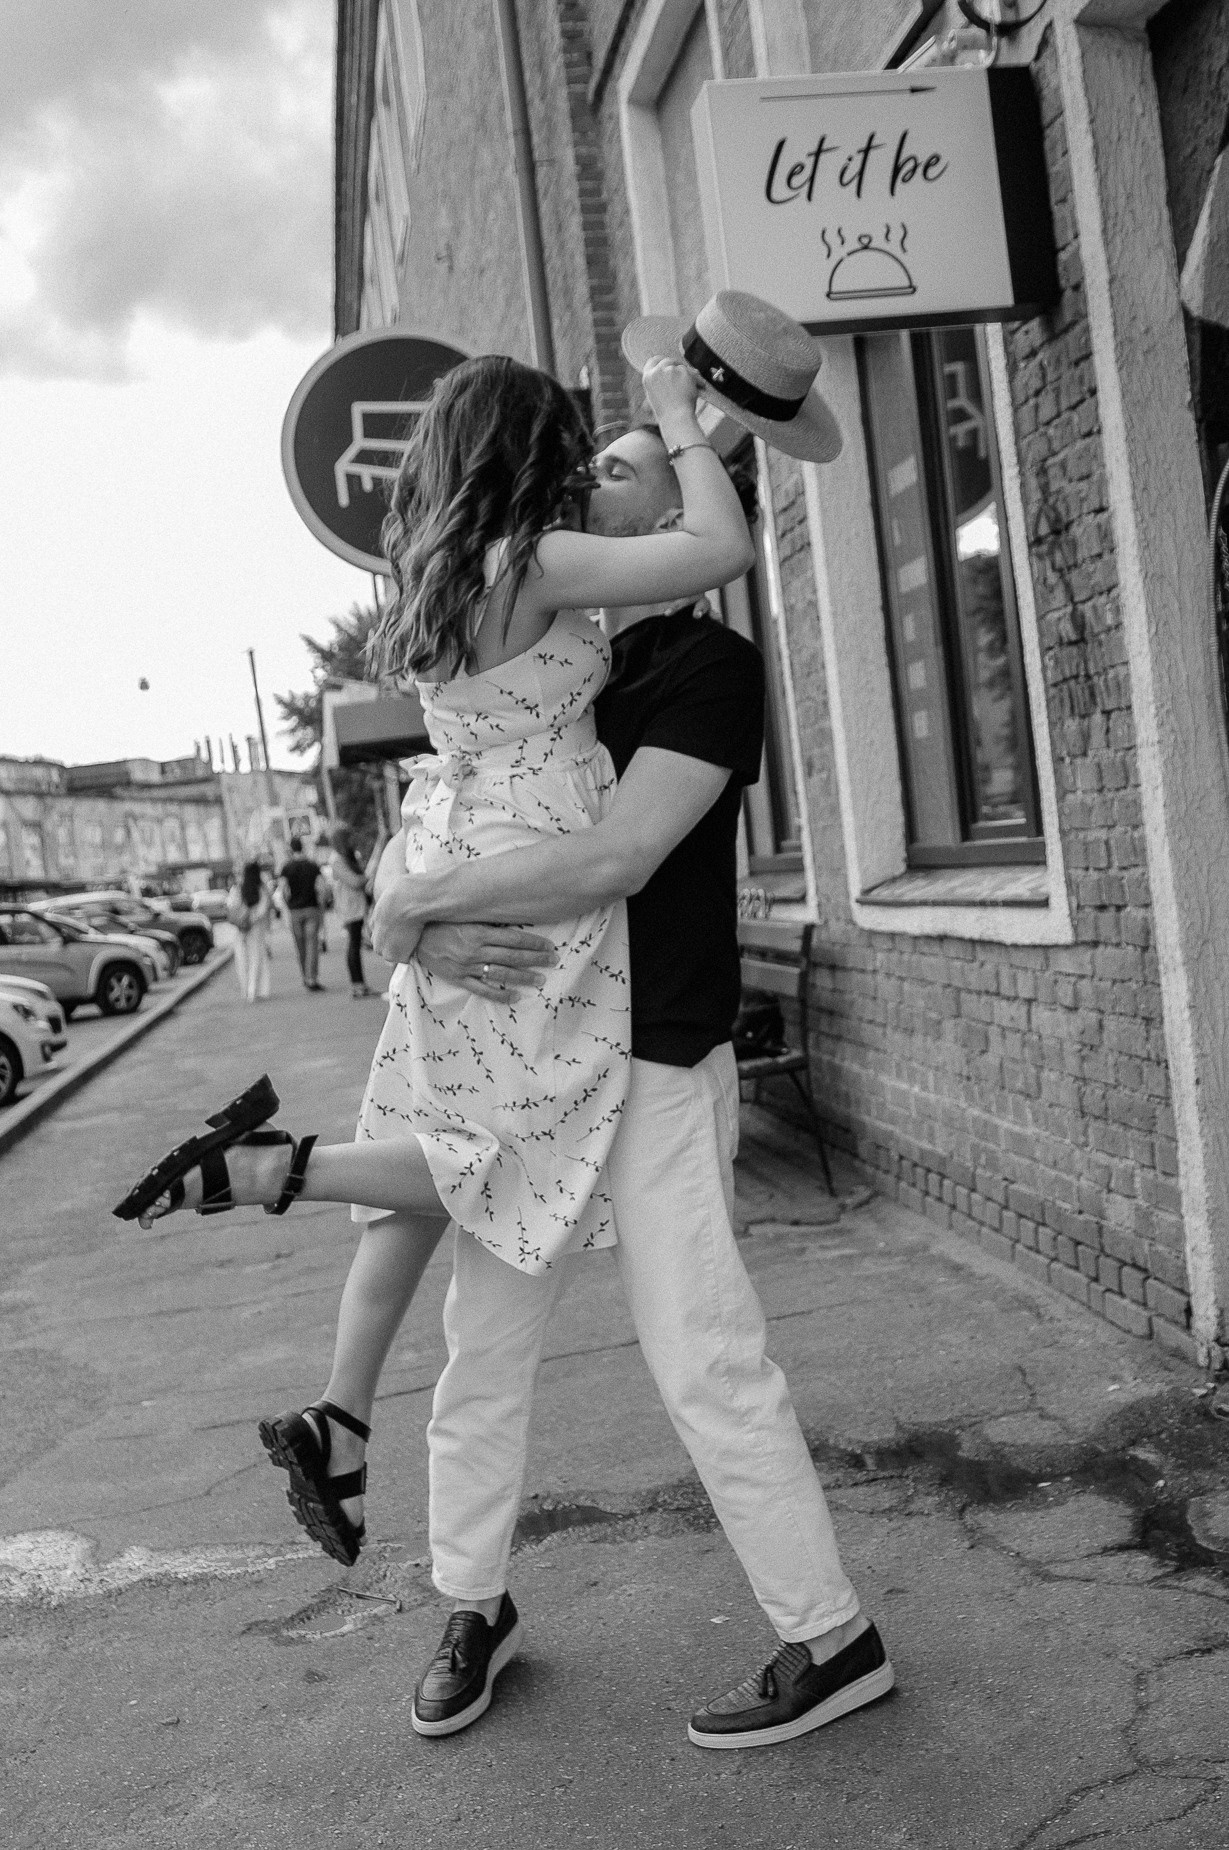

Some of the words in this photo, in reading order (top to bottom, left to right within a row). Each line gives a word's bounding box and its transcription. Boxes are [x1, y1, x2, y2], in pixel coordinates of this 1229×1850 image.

[764, 134, 841, 205] Let
[838, 130, 886, 199] it
[889, 128, 950, 197] be
